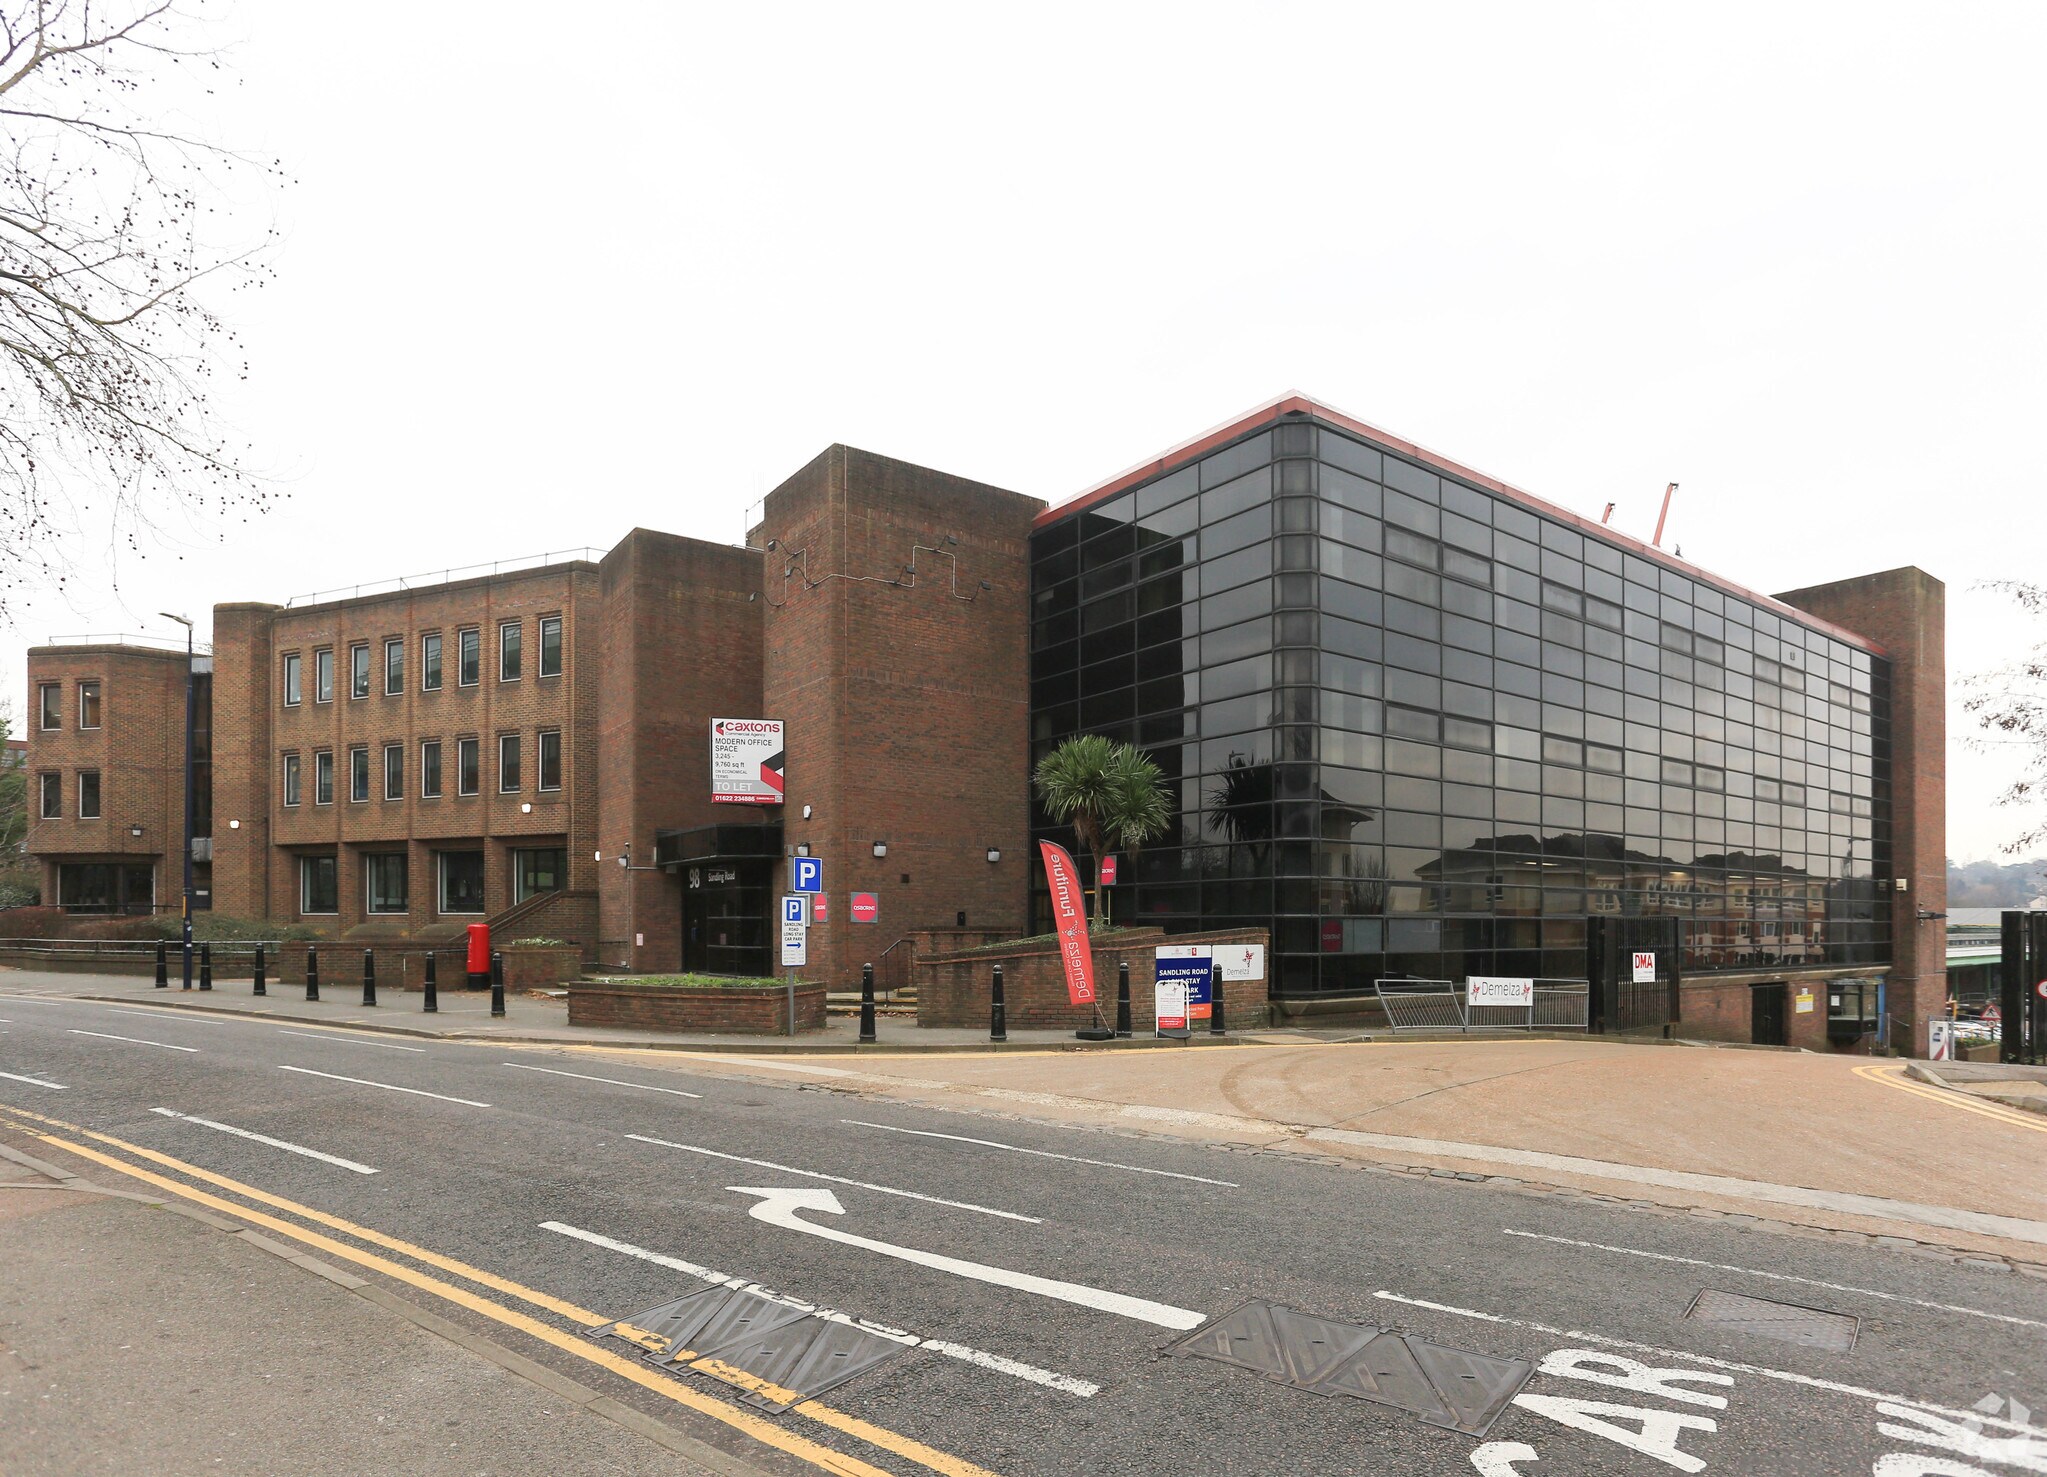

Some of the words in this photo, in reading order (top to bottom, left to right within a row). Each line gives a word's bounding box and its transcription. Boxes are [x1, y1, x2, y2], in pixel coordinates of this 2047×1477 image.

[725, 722, 780, 732] caxtons
[715, 782, 730, 791] TO
[733, 782, 753, 791] LET
[689, 868, 700, 888] 98
[725, 870, 735, 880] Road
[800, 862, 816, 888] P
[789, 901, 799, 920] P
[1635, 954, 1653, 969] DMA
[1159, 969, 1190, 977] SANDLING
[1227, 968, 1250, 976] Demelza
[1482, 981, 1521, 997] Demelza
